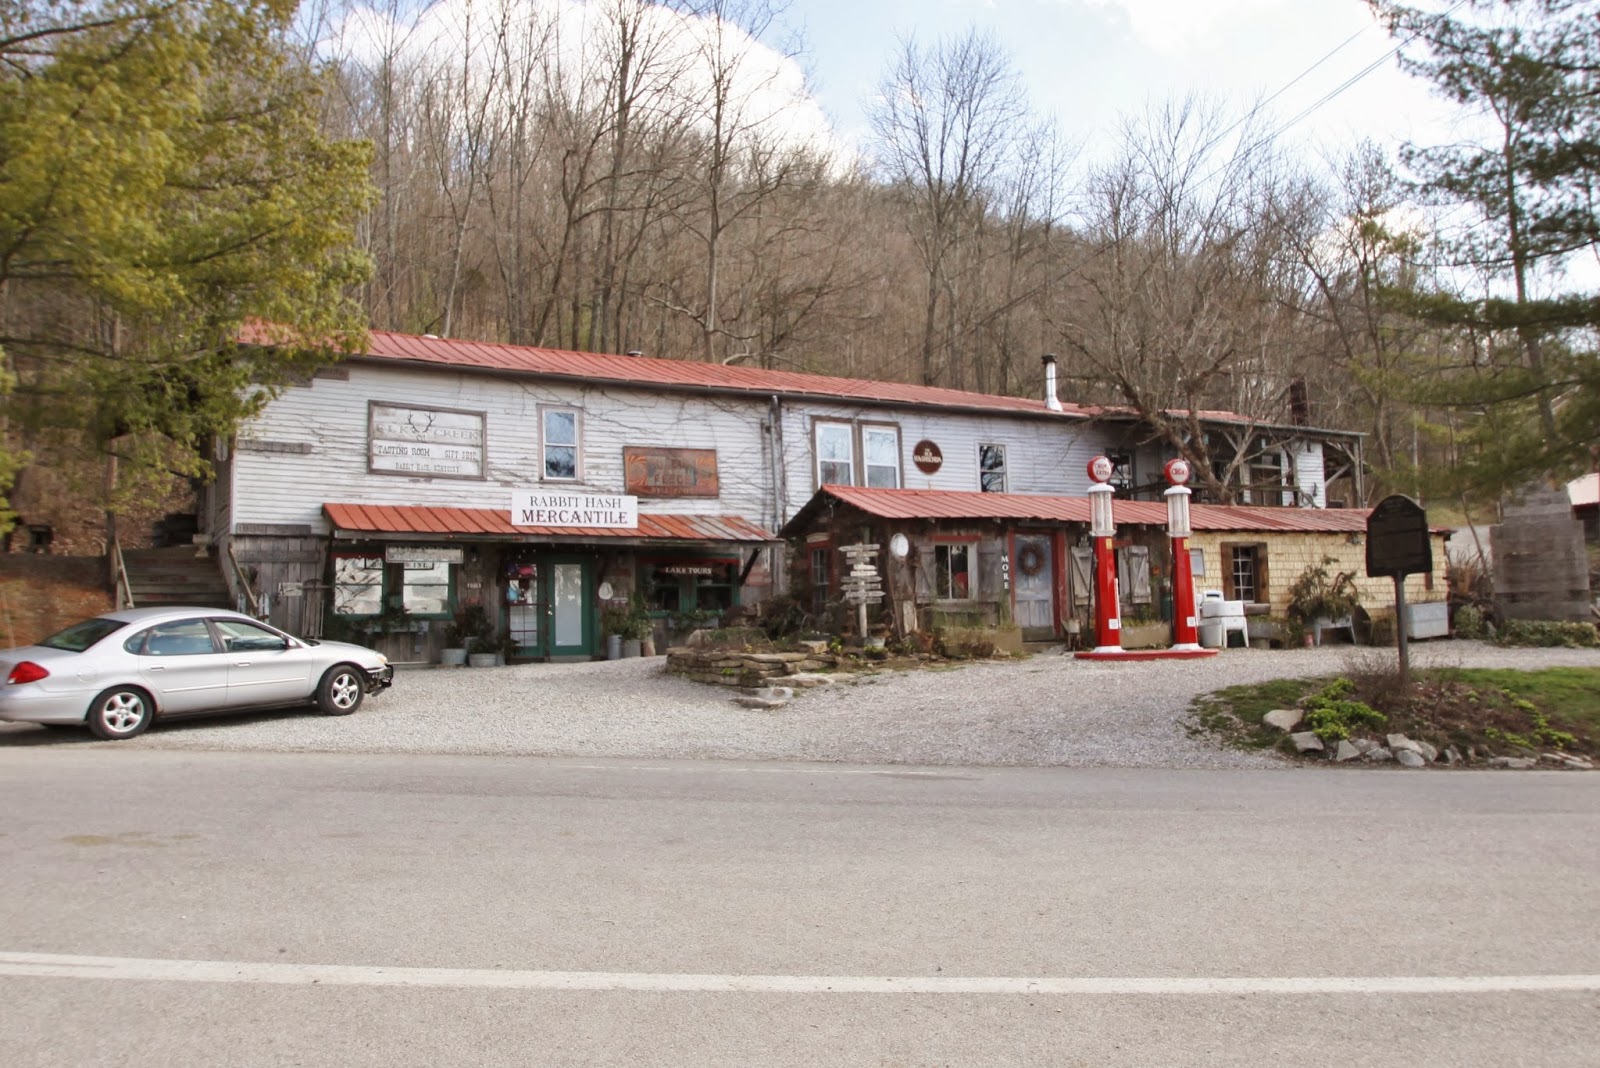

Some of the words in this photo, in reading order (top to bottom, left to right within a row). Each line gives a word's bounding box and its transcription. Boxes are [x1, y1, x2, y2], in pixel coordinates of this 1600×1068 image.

[433, 428, 479, 440] CREEK
[378, 445, 408, 456] TASTING
[411, 447, 430, 457] ROOM
[444, 449, 459, 459] GIFT
[461, 451, 477, 461] SHOP
[530, 495, 581, 508] RABBIT
[585, 496, 622, 509] HASH
[521, 508, 628, 525] MERCANTILE
[665, 566, 687, 574] LAKE
[688, 567, 713, 575] TOURS
[1000, 555, 1010, 590] MORE
